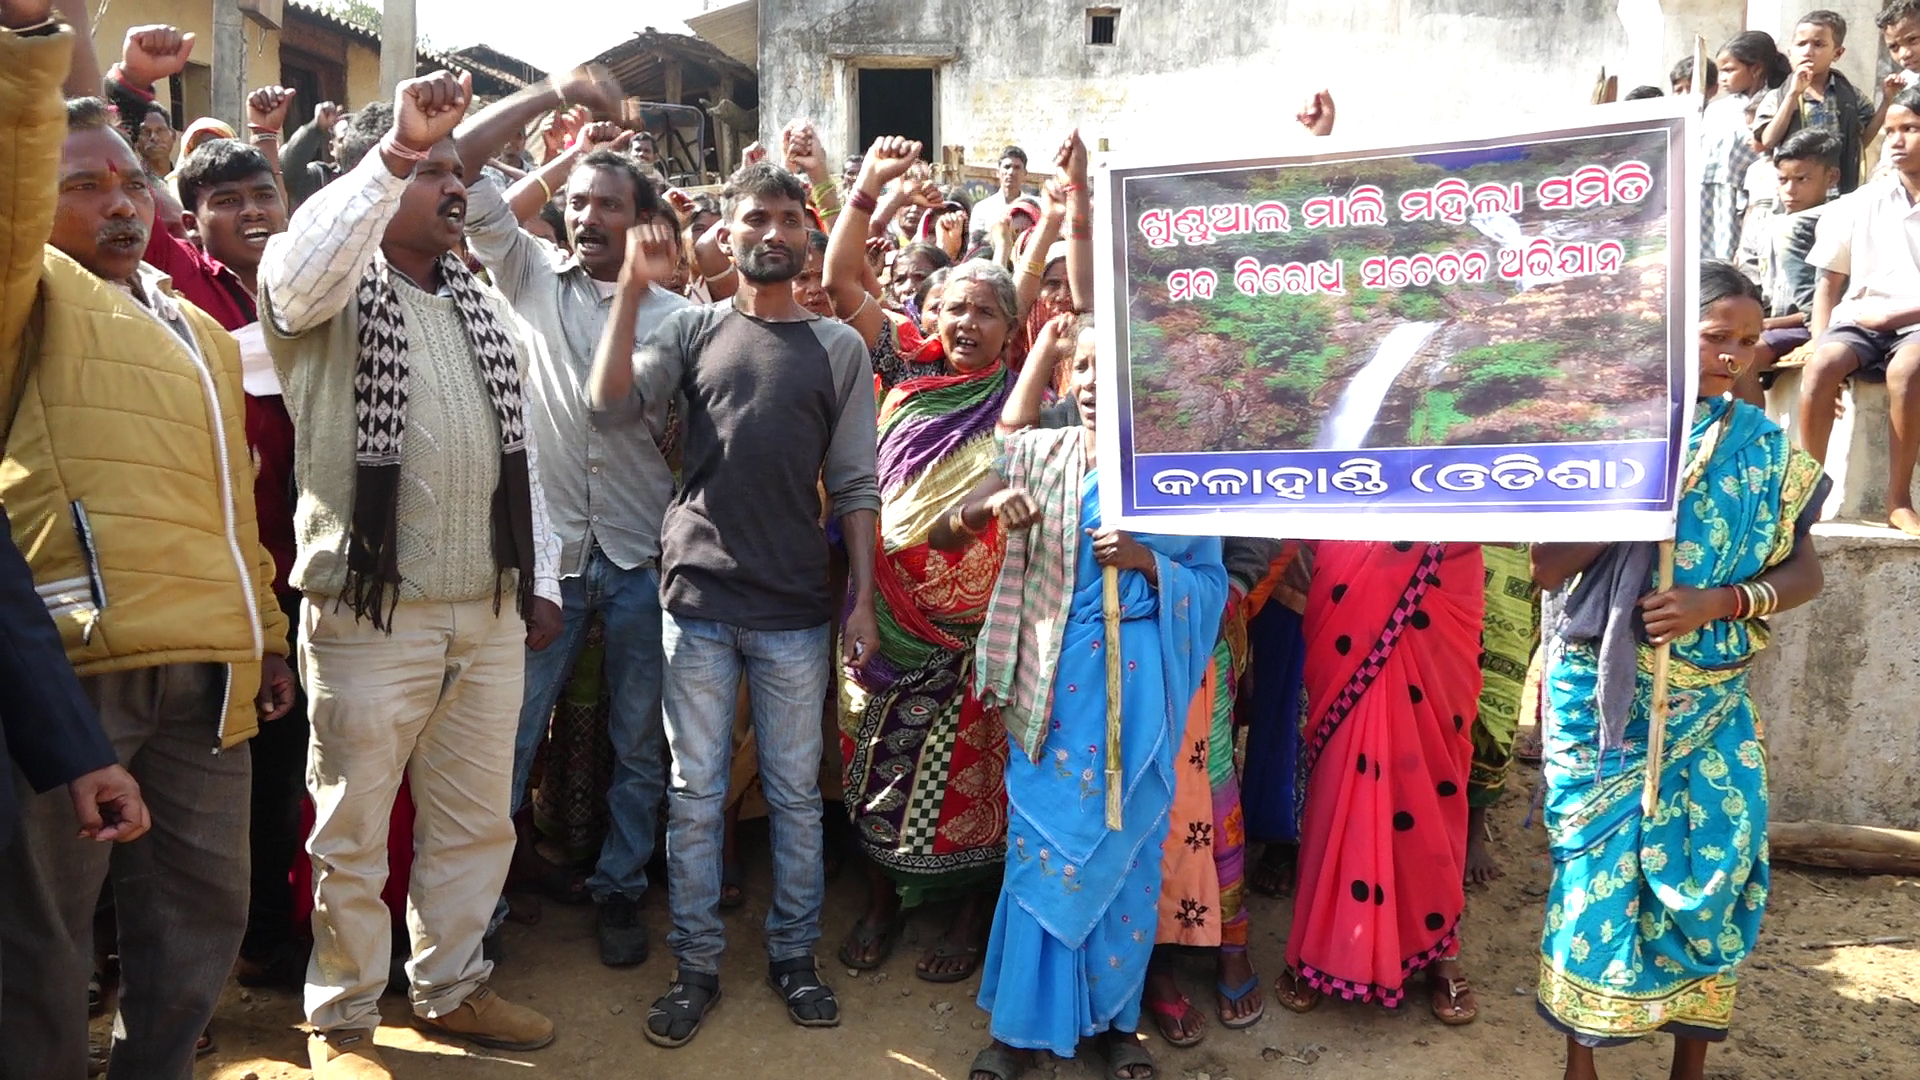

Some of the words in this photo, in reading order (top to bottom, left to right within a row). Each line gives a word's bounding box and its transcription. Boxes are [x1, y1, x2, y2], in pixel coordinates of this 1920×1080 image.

[1303, 186, 1386, 227] ମାଲି
[1400, 179, 1522, 223] ମହିଲା
[1539, 161, 1651, 208] ସମିତି
[1168, 268, 1216, 300] ମଦ
[1361, 251, 1488, 288] ସଚେତନ
[1499, 239, 1624, 279] ଅଭିଯାନ
[1152, 458, 1388, 500] କଳାହାଣ୍ଡି
